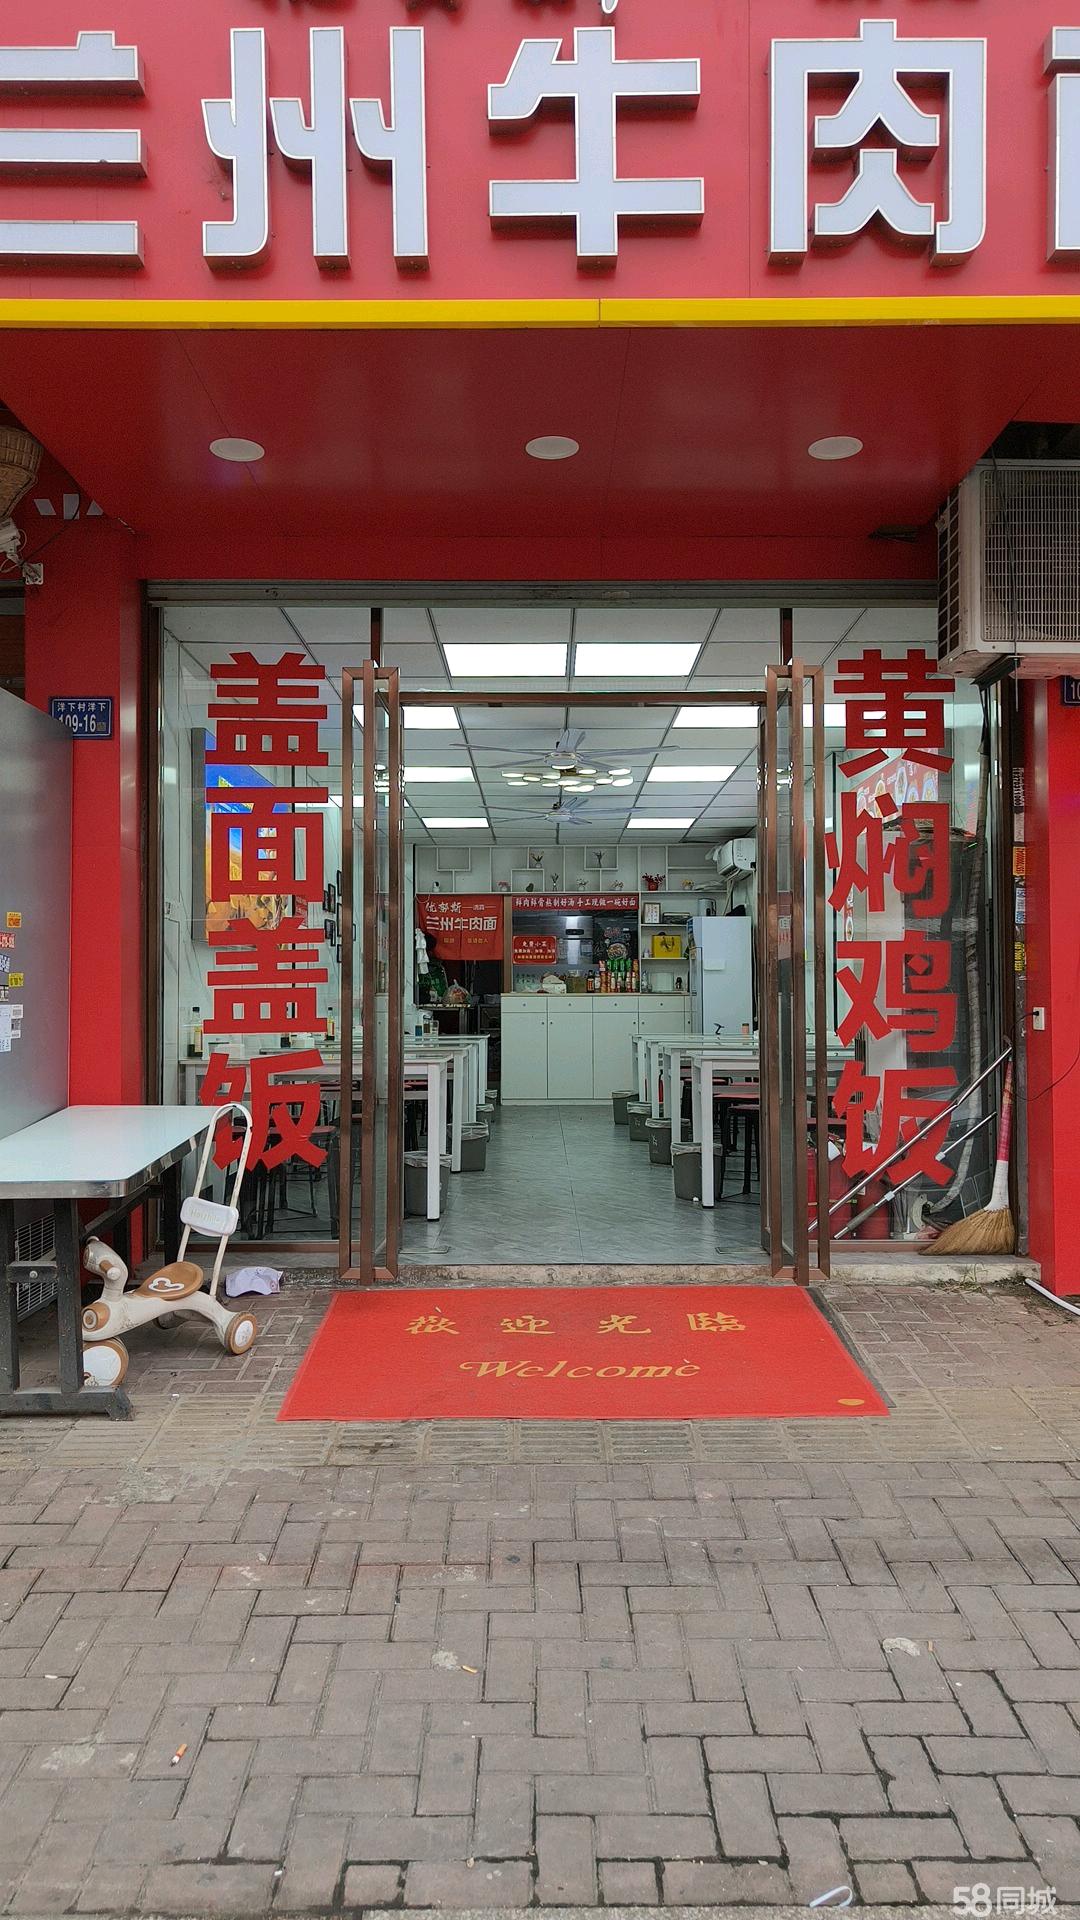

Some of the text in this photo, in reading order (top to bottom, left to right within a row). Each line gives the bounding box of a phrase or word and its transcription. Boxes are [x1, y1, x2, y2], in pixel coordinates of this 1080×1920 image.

[0, 18, 1080, 265] 兰州牛肉
[58, 702, 106, 712] 洋下村洋下
[201, 652, 328, 1171] 盖面盖饭
[828, 649, 958, 1186] 黄焖鸡饭
[459, 1359, 701, 1379] Welcome
